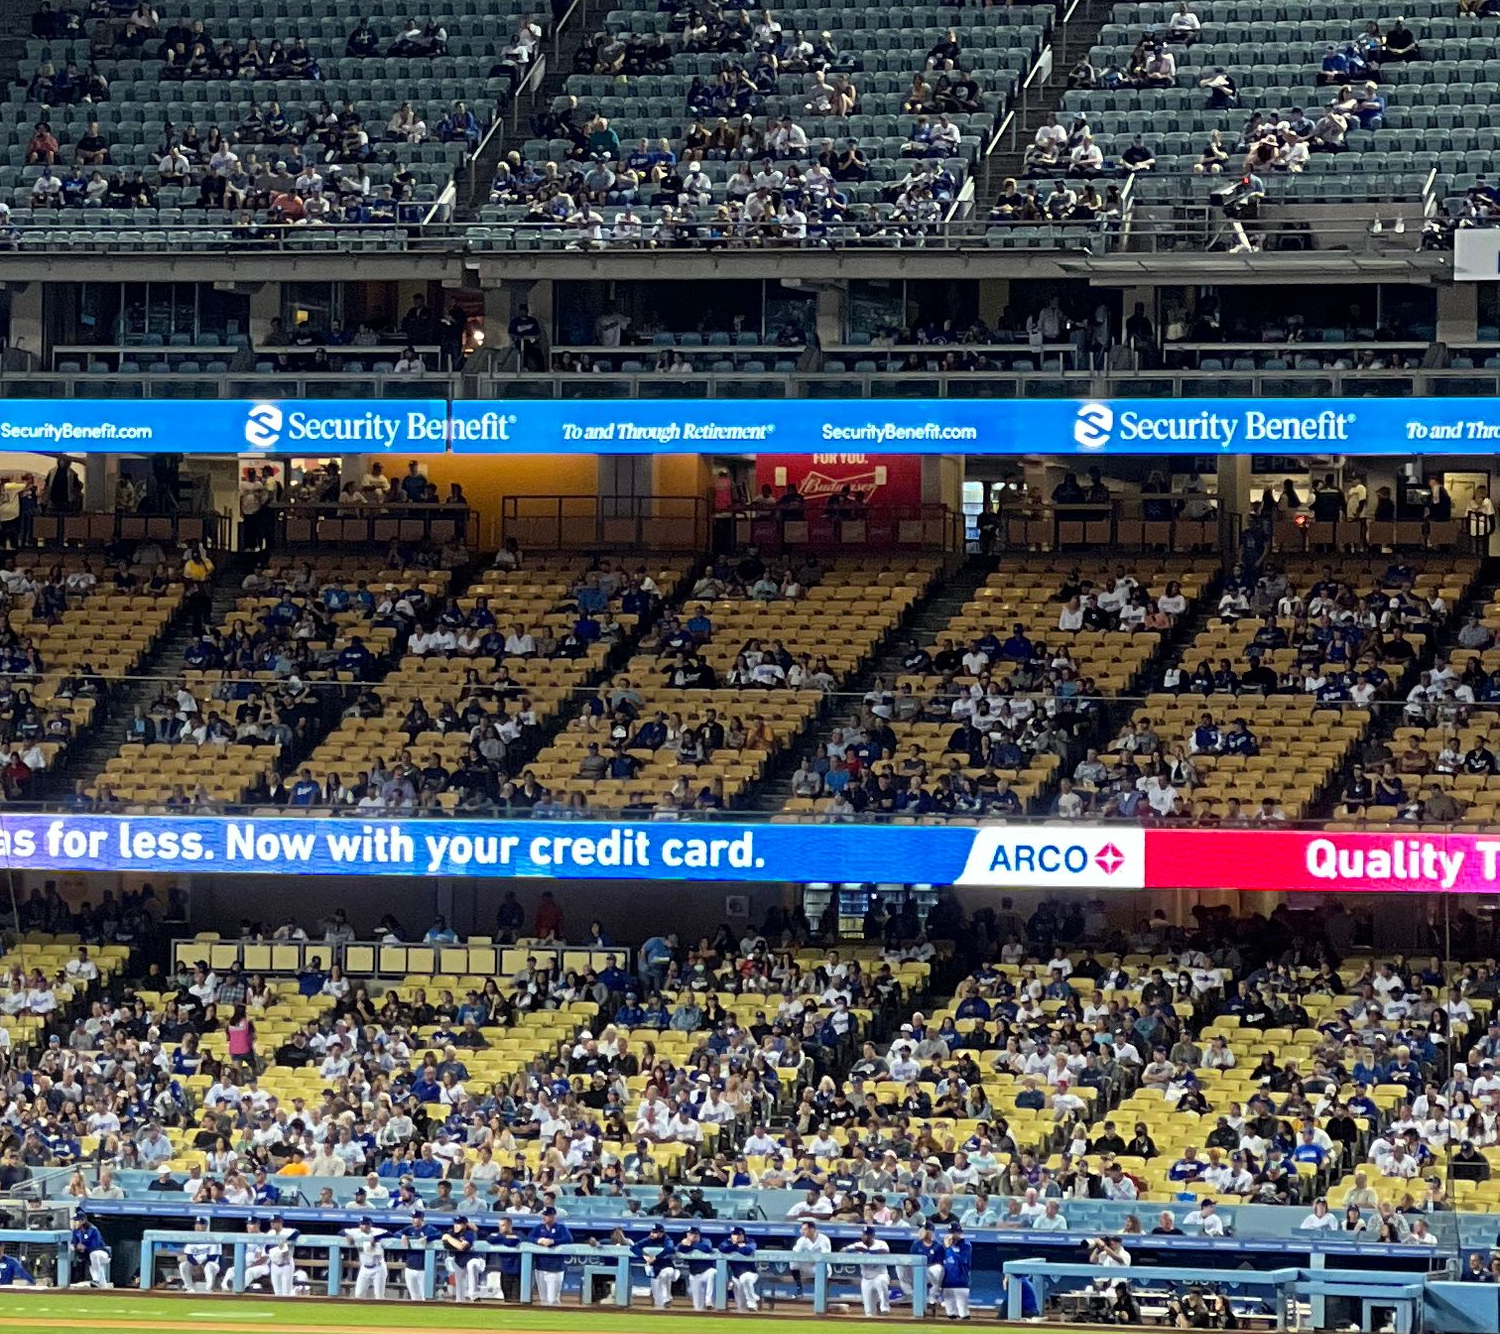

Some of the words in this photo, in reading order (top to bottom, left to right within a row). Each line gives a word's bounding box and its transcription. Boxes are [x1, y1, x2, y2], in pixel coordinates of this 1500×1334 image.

[1, 422, 152, 442] SecurityBenefit.com
[289, 411, 400, 447] Security
[563, 424, 582, 440] To
[584, 423, 614, 440] and
[617, 424, 680, 443] Through
[822, 423, 977, 444] SecurityBenefit.com
[1120, 411, 1238, 448] Security
[1406, 422, 1428, 440] To
[1430, 421, 1463, 440] and
[46, 821, 108, 858] for
[119, 822, 214, 860] less.
[226, 823, 316, 861] Now
[327, 825, 414, 862] with
[425, 835, 519, 872] your
[530, 829, 649, 866] credit
[662, 831, 764, 868] card.
[989, 844, 1088, 874] ARCO
[1306, 838, 1465, 889] Quality
